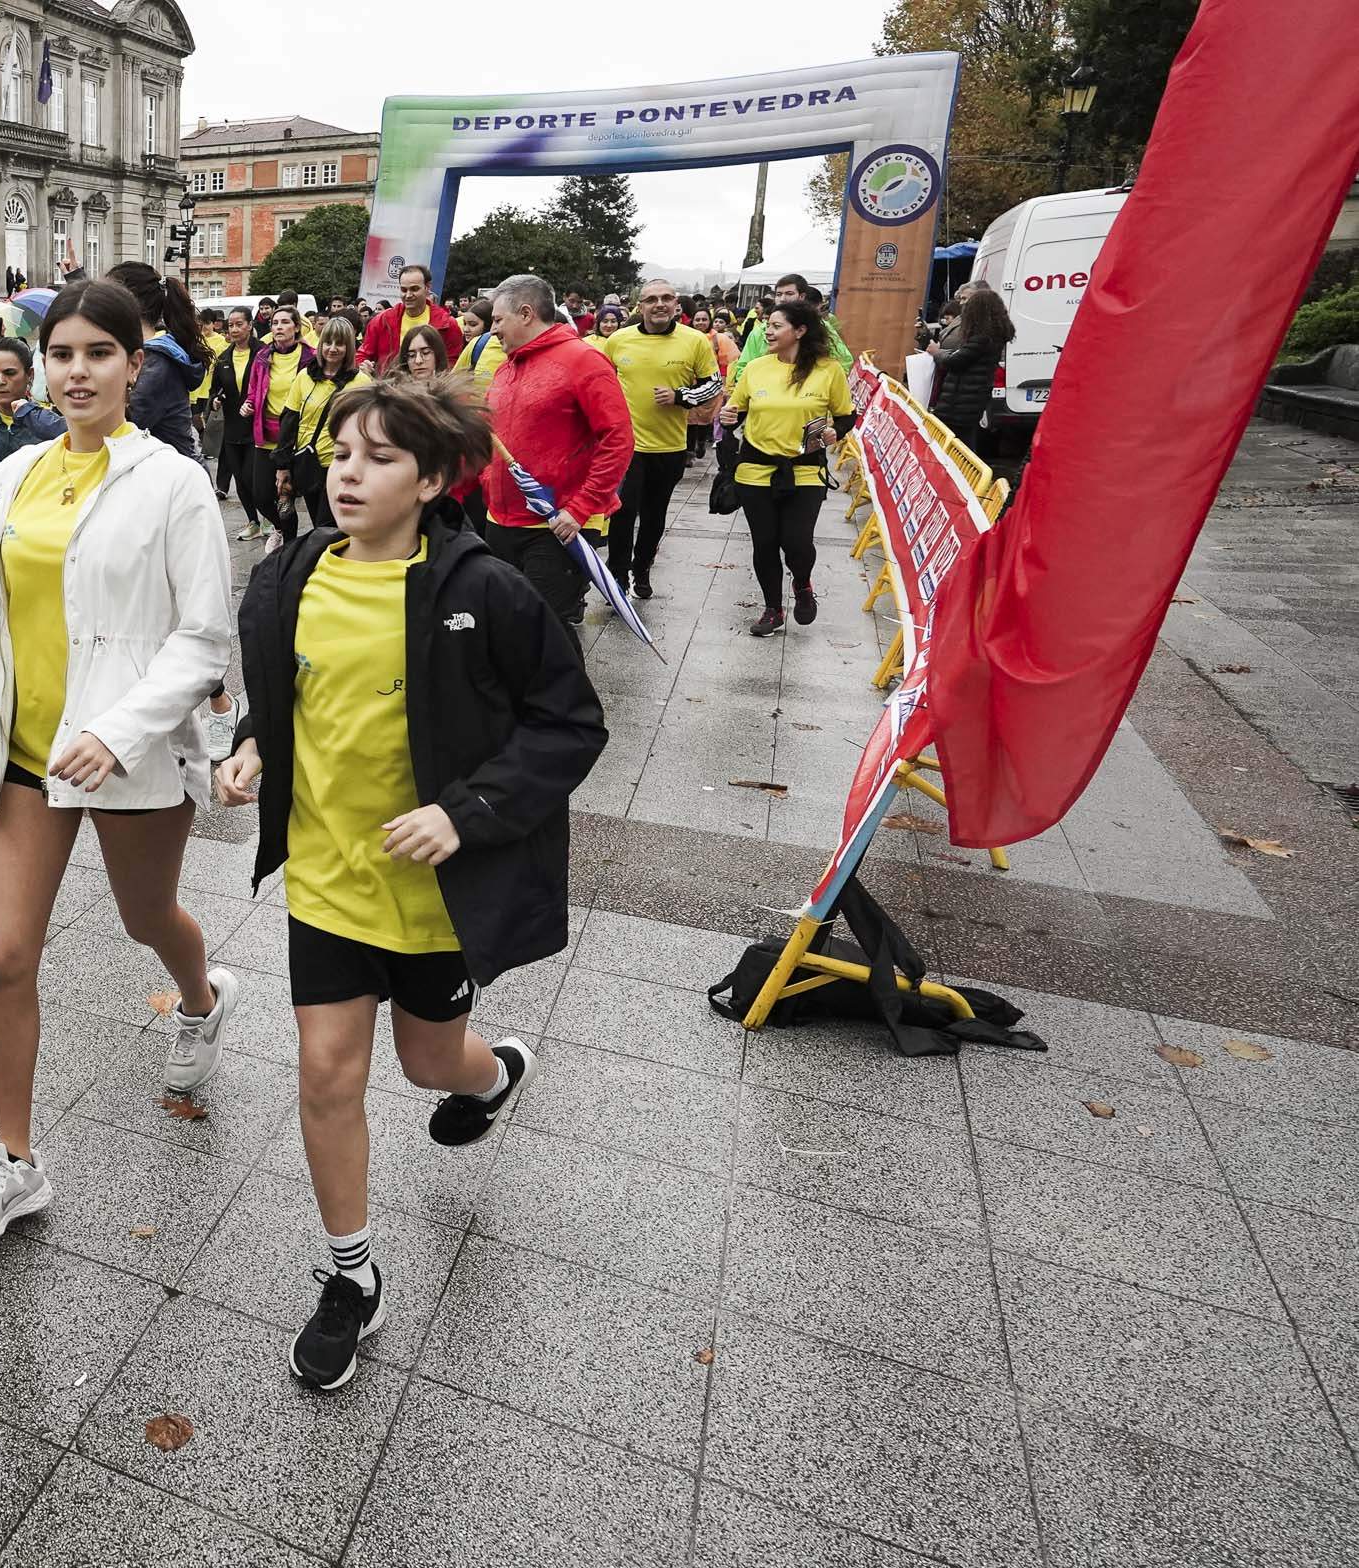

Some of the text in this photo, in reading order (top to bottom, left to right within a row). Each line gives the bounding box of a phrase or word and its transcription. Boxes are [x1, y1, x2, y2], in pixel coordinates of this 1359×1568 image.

[453, 86, 857, 131] DEPORTE PONTEVEDRA
[588, 127, 693, 142] deportes.pontevedra.gal
[867, 155, 926, 174] DEPORTE
[861, 187, 929, 217] PONTEVEDRA
